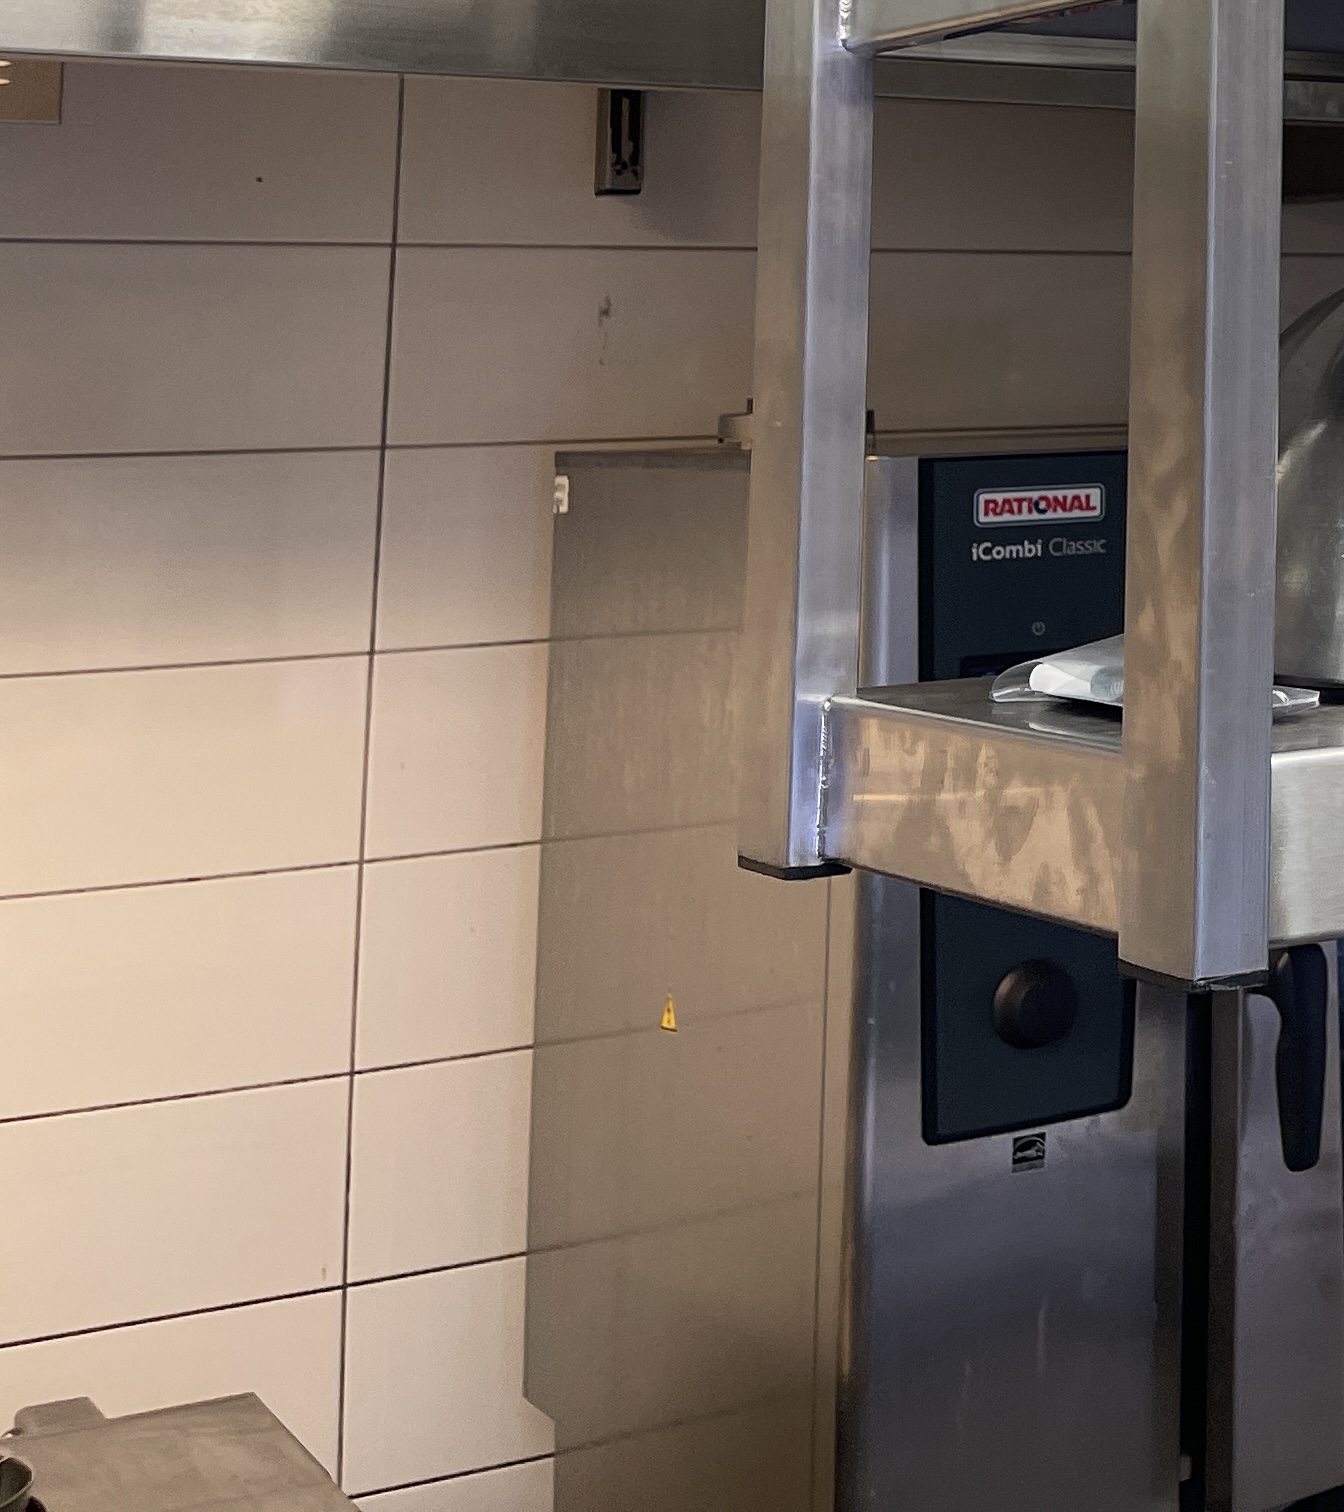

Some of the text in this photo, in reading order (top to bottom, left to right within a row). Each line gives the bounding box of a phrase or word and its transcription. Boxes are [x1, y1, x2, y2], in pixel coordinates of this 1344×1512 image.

[983, 493, 1097, 518] RATIONAL
[971, 537, 1108, 562] iCombi Classic
